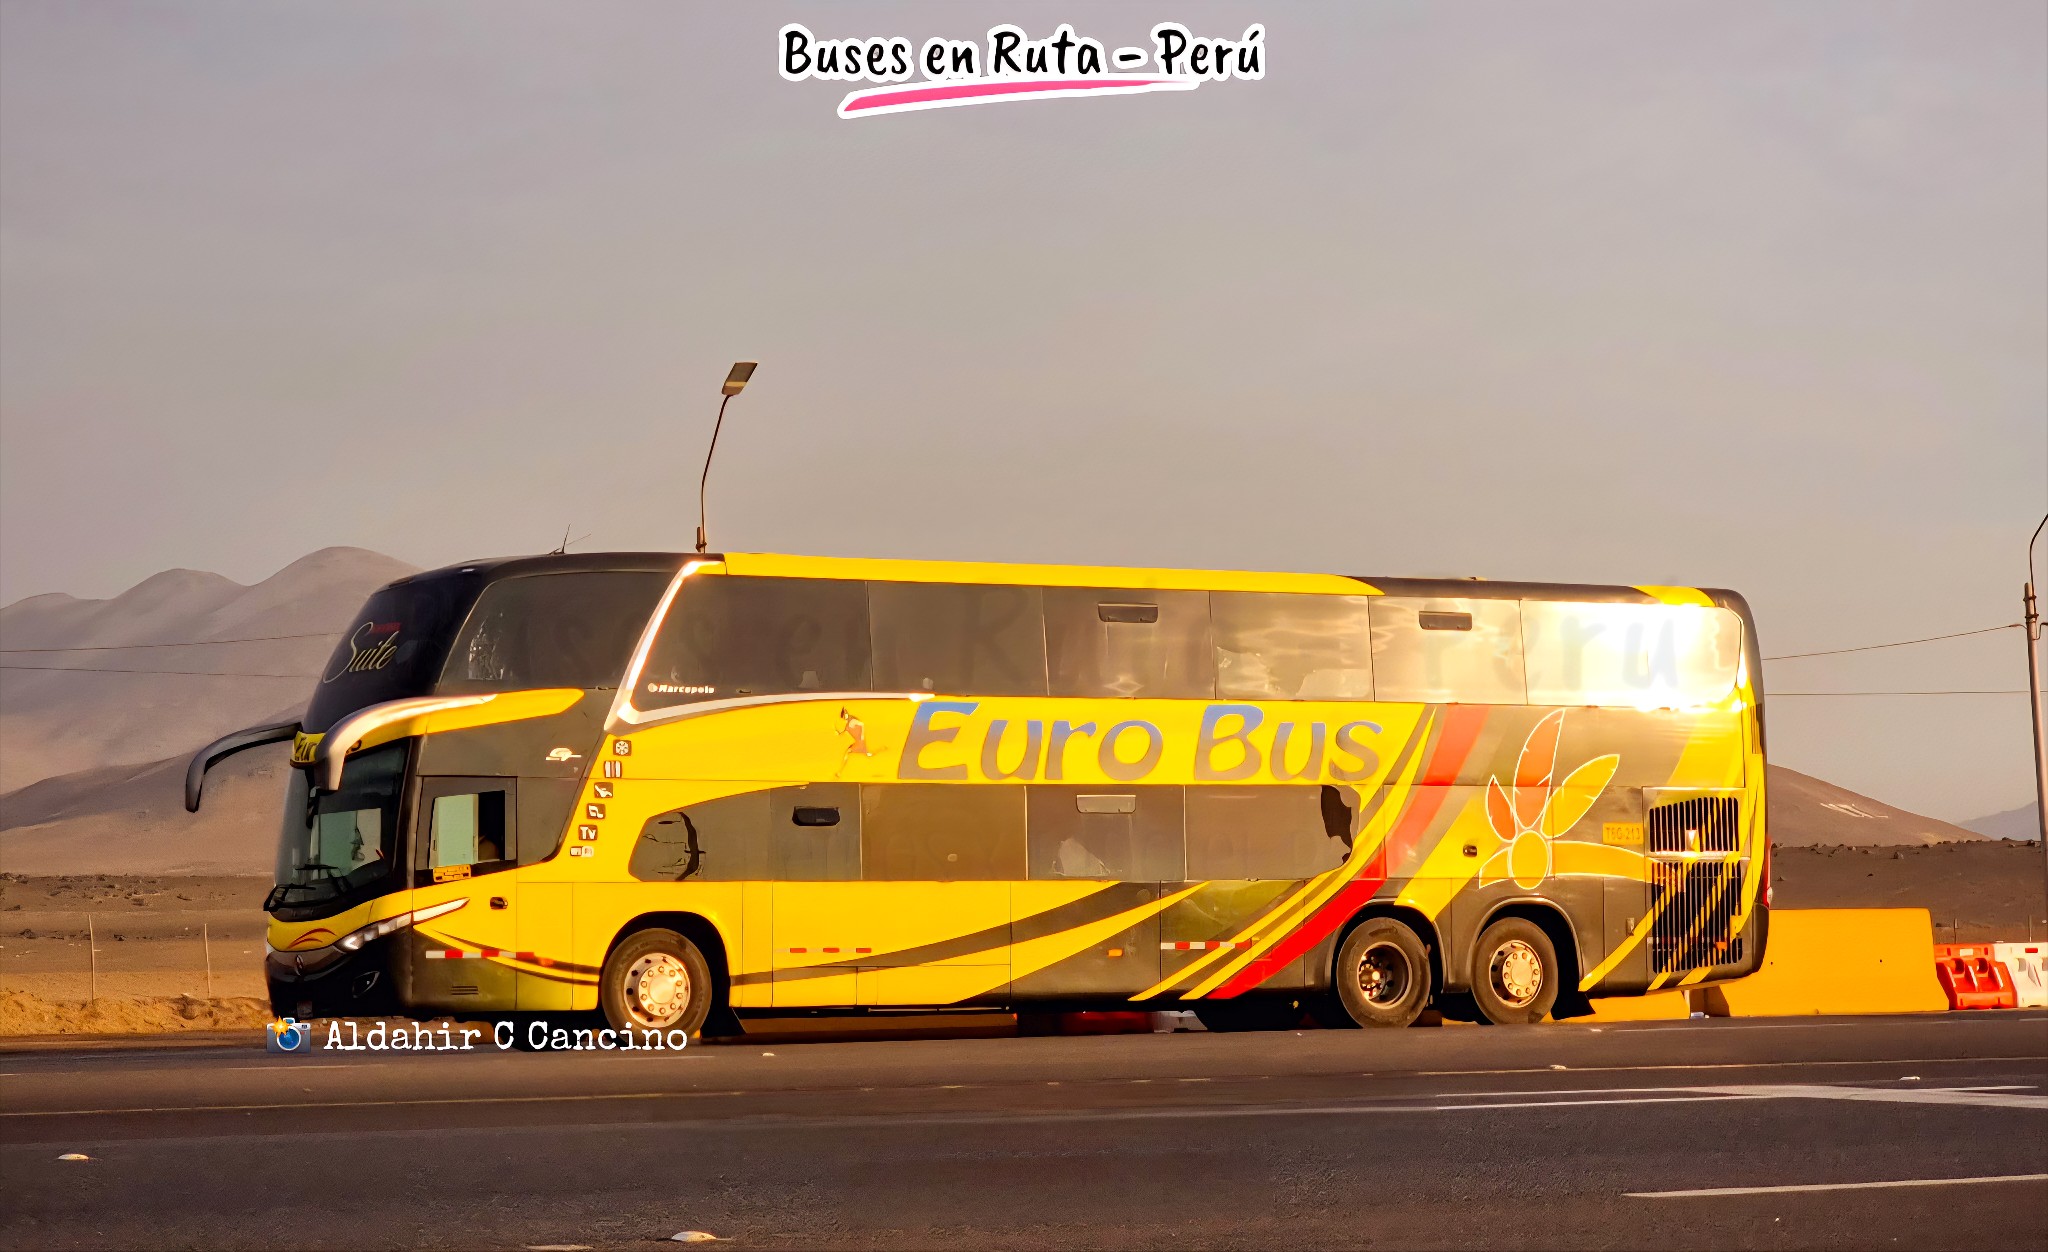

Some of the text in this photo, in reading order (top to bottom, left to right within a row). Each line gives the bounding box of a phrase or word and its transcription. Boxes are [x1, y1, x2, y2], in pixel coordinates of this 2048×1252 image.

[323, 621, 400, 683] Suite
[897, 701, 1384, 782] Euro Bus
